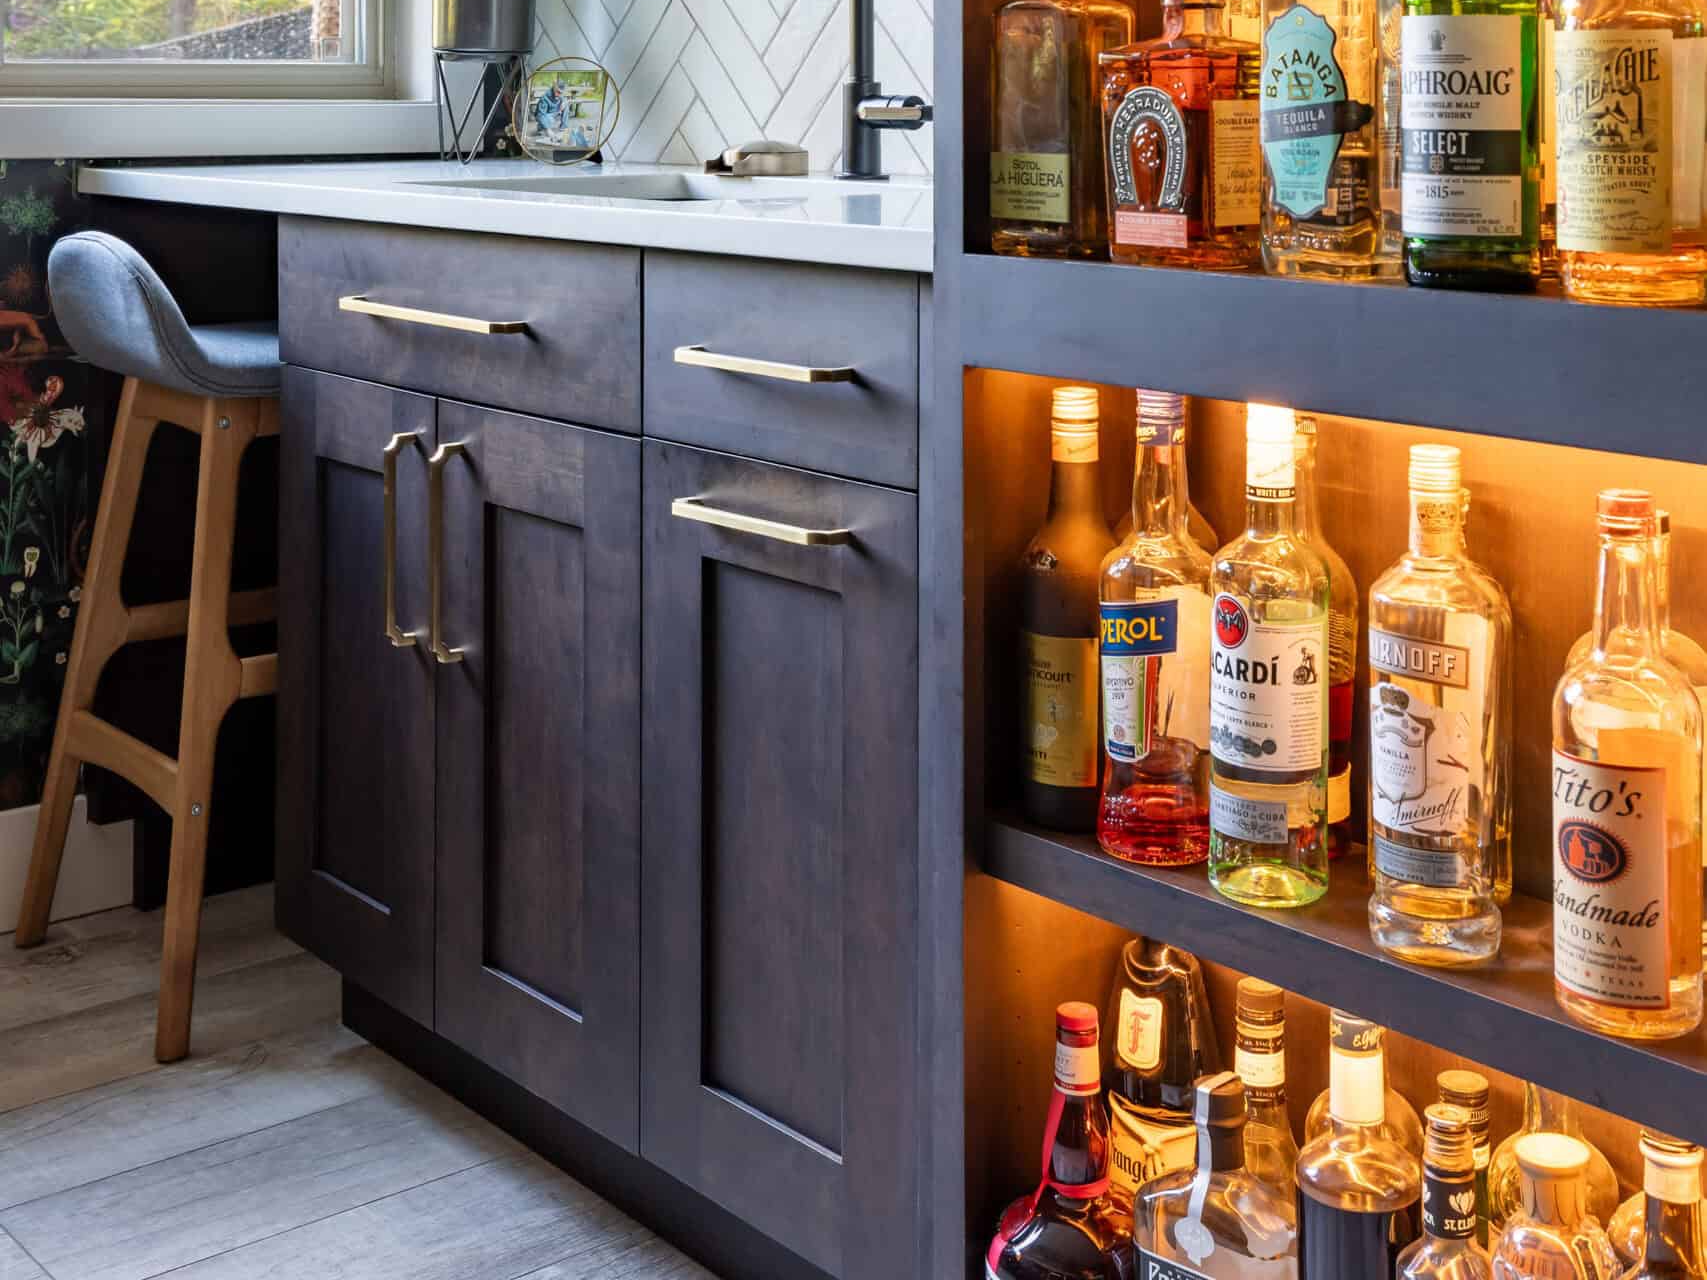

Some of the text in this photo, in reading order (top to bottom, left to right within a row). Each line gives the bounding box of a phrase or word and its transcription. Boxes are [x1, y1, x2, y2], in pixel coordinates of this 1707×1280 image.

[1266, 49, 1337, 99] BATANGA
[1455, 100, 1481, 109] MALT
[1116, 97, 1178, 135] HERRADURA
[1277, 108, 1326, 126] TEQUILA
[1437, 111, 1473, 120] WHISKY
[1412, 131, 1470, 155] SELECT
[1587, 154, 1650, 165] SPEYSIDE
[1617, 166, 1657, 177] WHISKY
[1424, 184, 1449, 201] 1815
[1554, 766, 1642, 818] Tito's
[1258, 812, 1286, 822] CUBA
[1562, 920, 1623, 950] VODKA
